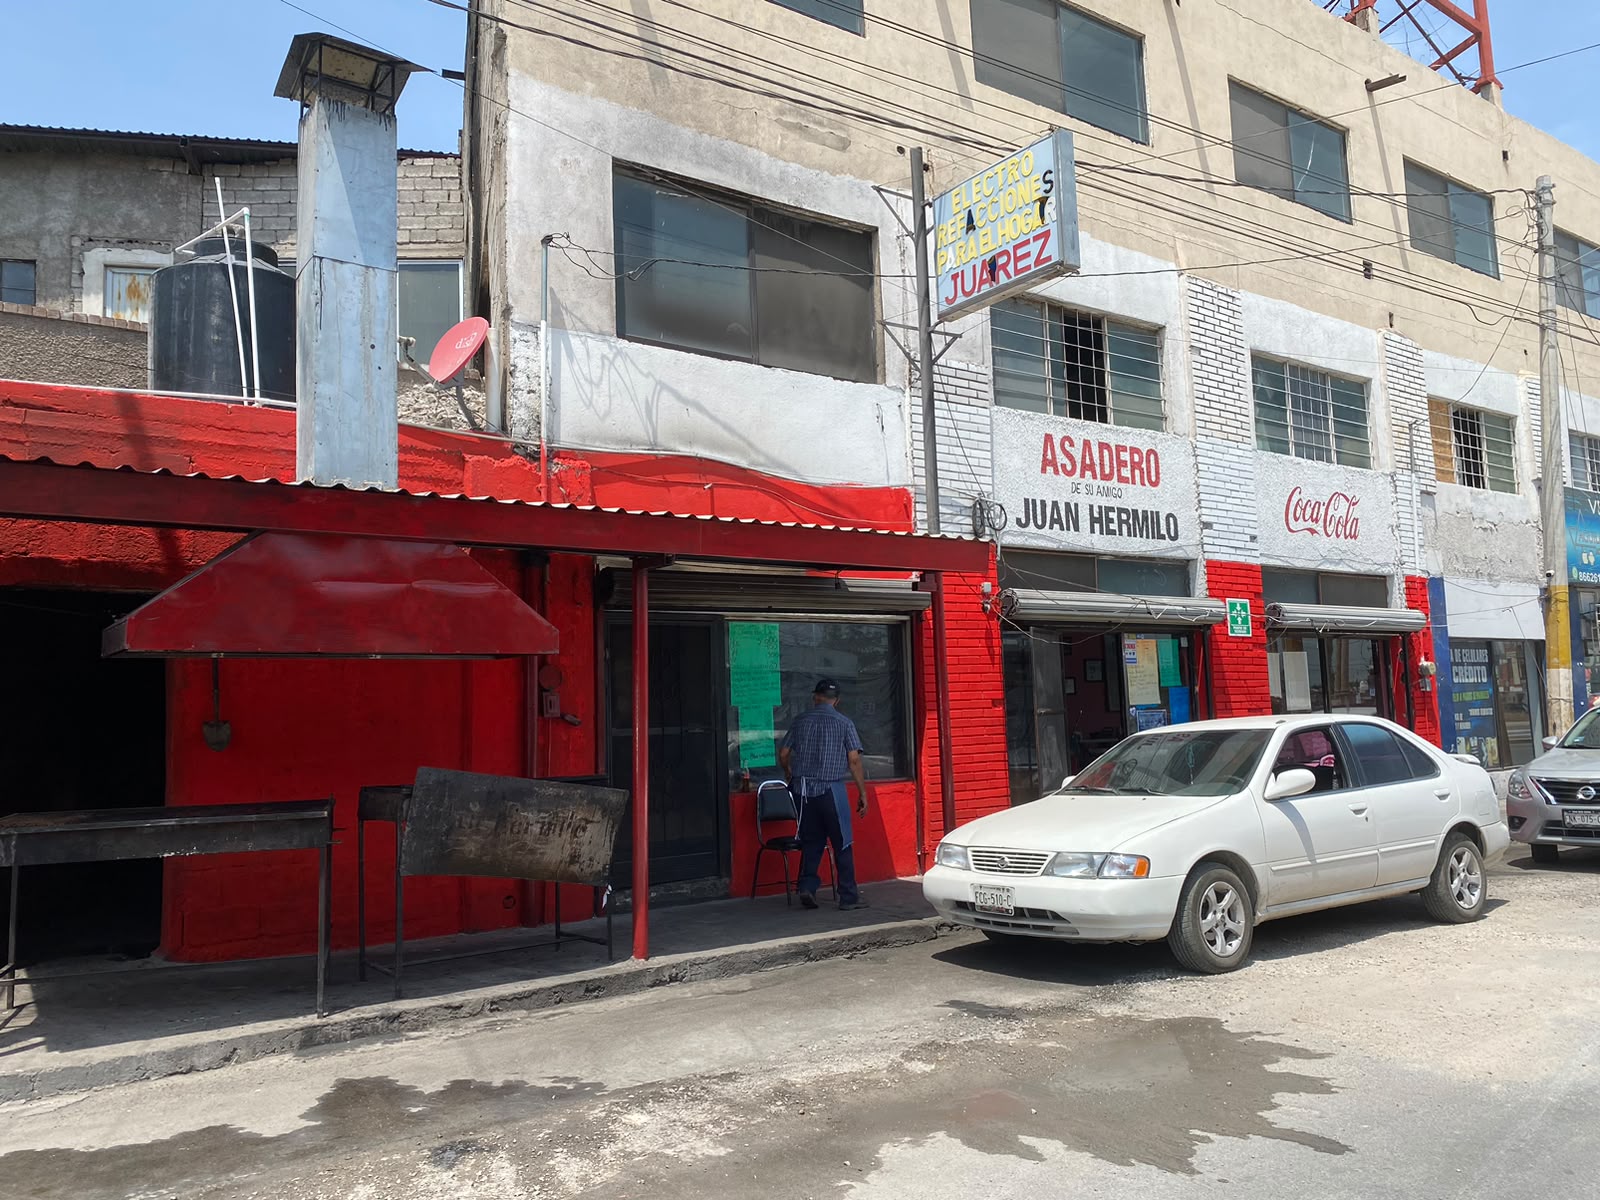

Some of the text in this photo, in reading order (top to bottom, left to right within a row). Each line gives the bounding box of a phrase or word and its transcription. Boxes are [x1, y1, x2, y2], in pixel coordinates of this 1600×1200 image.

[937, 169, 1054, 249] REFACCIONES
[951, 150, 1034, 215] ELECTRO
[937, 238, 979, 276] PARA
[945, 229, 1053, 305] JUAREZ
[1040, 433, 1161, 488] ASADERO
[1071, 481, 1123, 499] DE SU AMIGO
[1015, 497, 1179, 542] JUAN HERMILO
